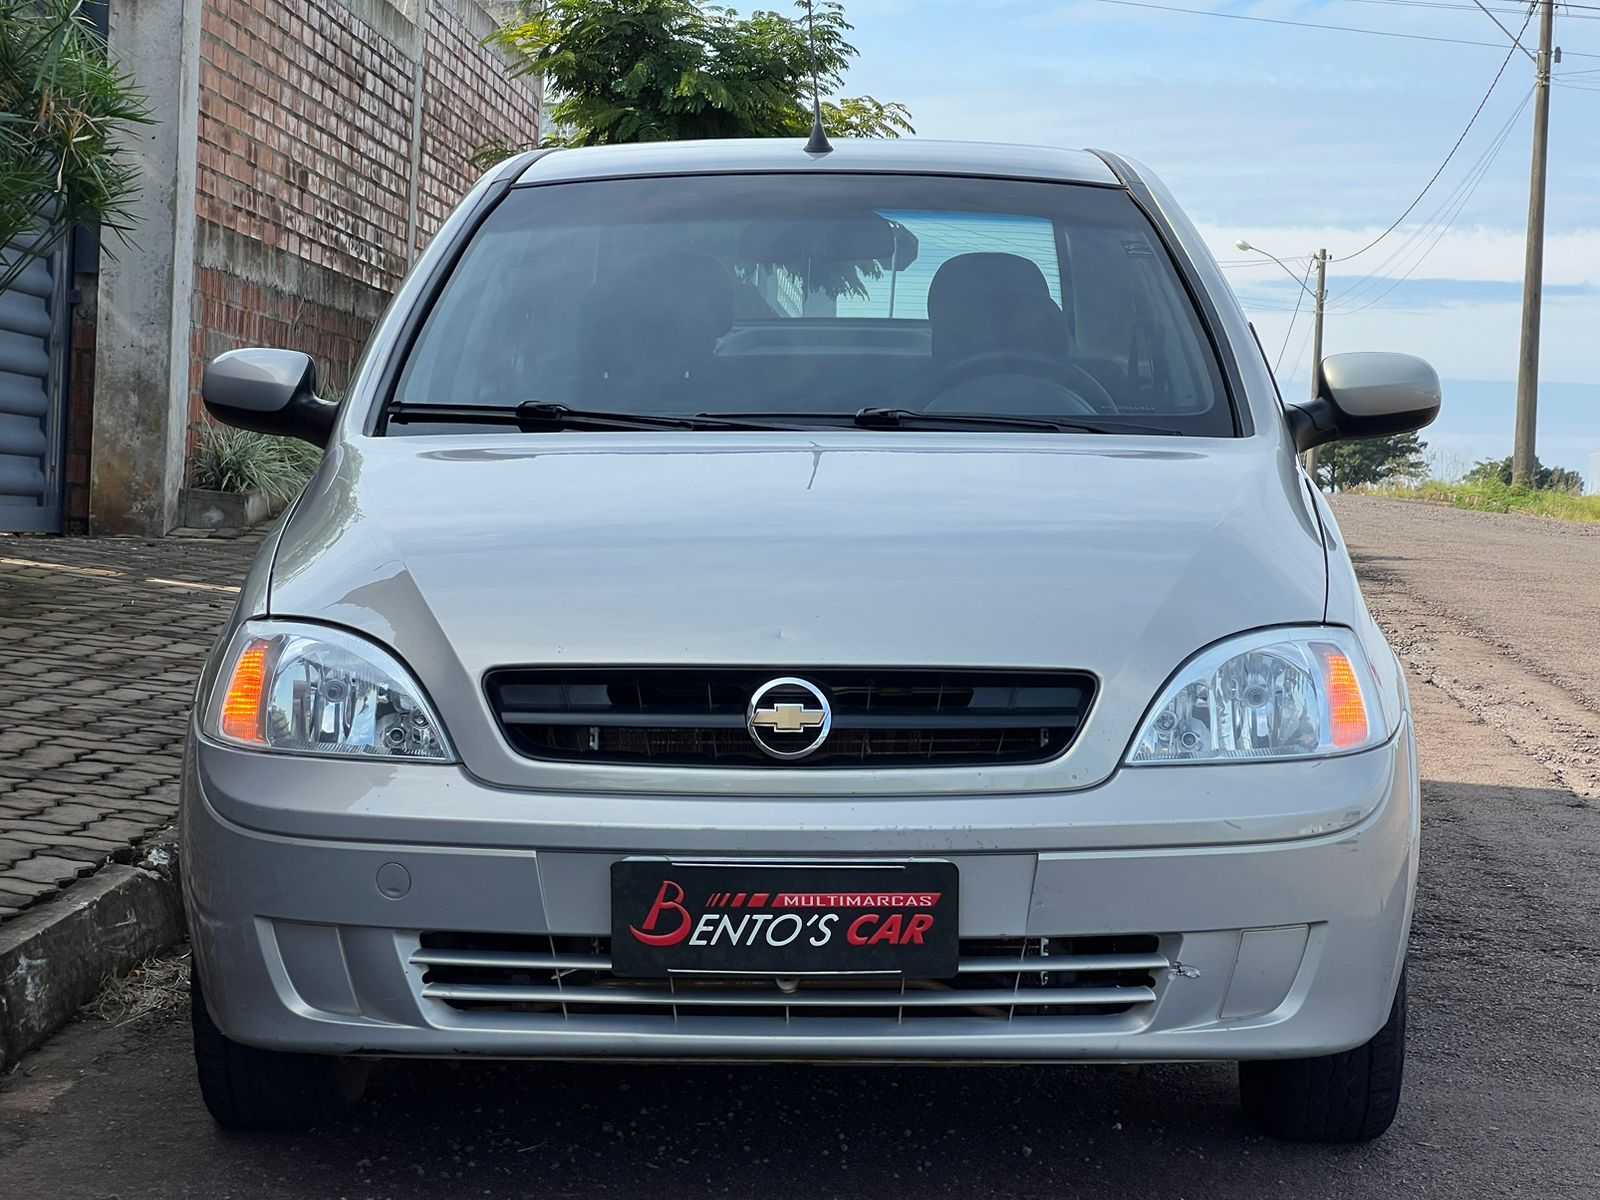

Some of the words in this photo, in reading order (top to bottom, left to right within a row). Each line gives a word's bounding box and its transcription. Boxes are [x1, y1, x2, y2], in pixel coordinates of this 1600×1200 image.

[629, 880, 839, 947] BENTO'S
[847, 913, 934, 945] CAR
[784, 895, 933, 907] MULTIMARCAS
